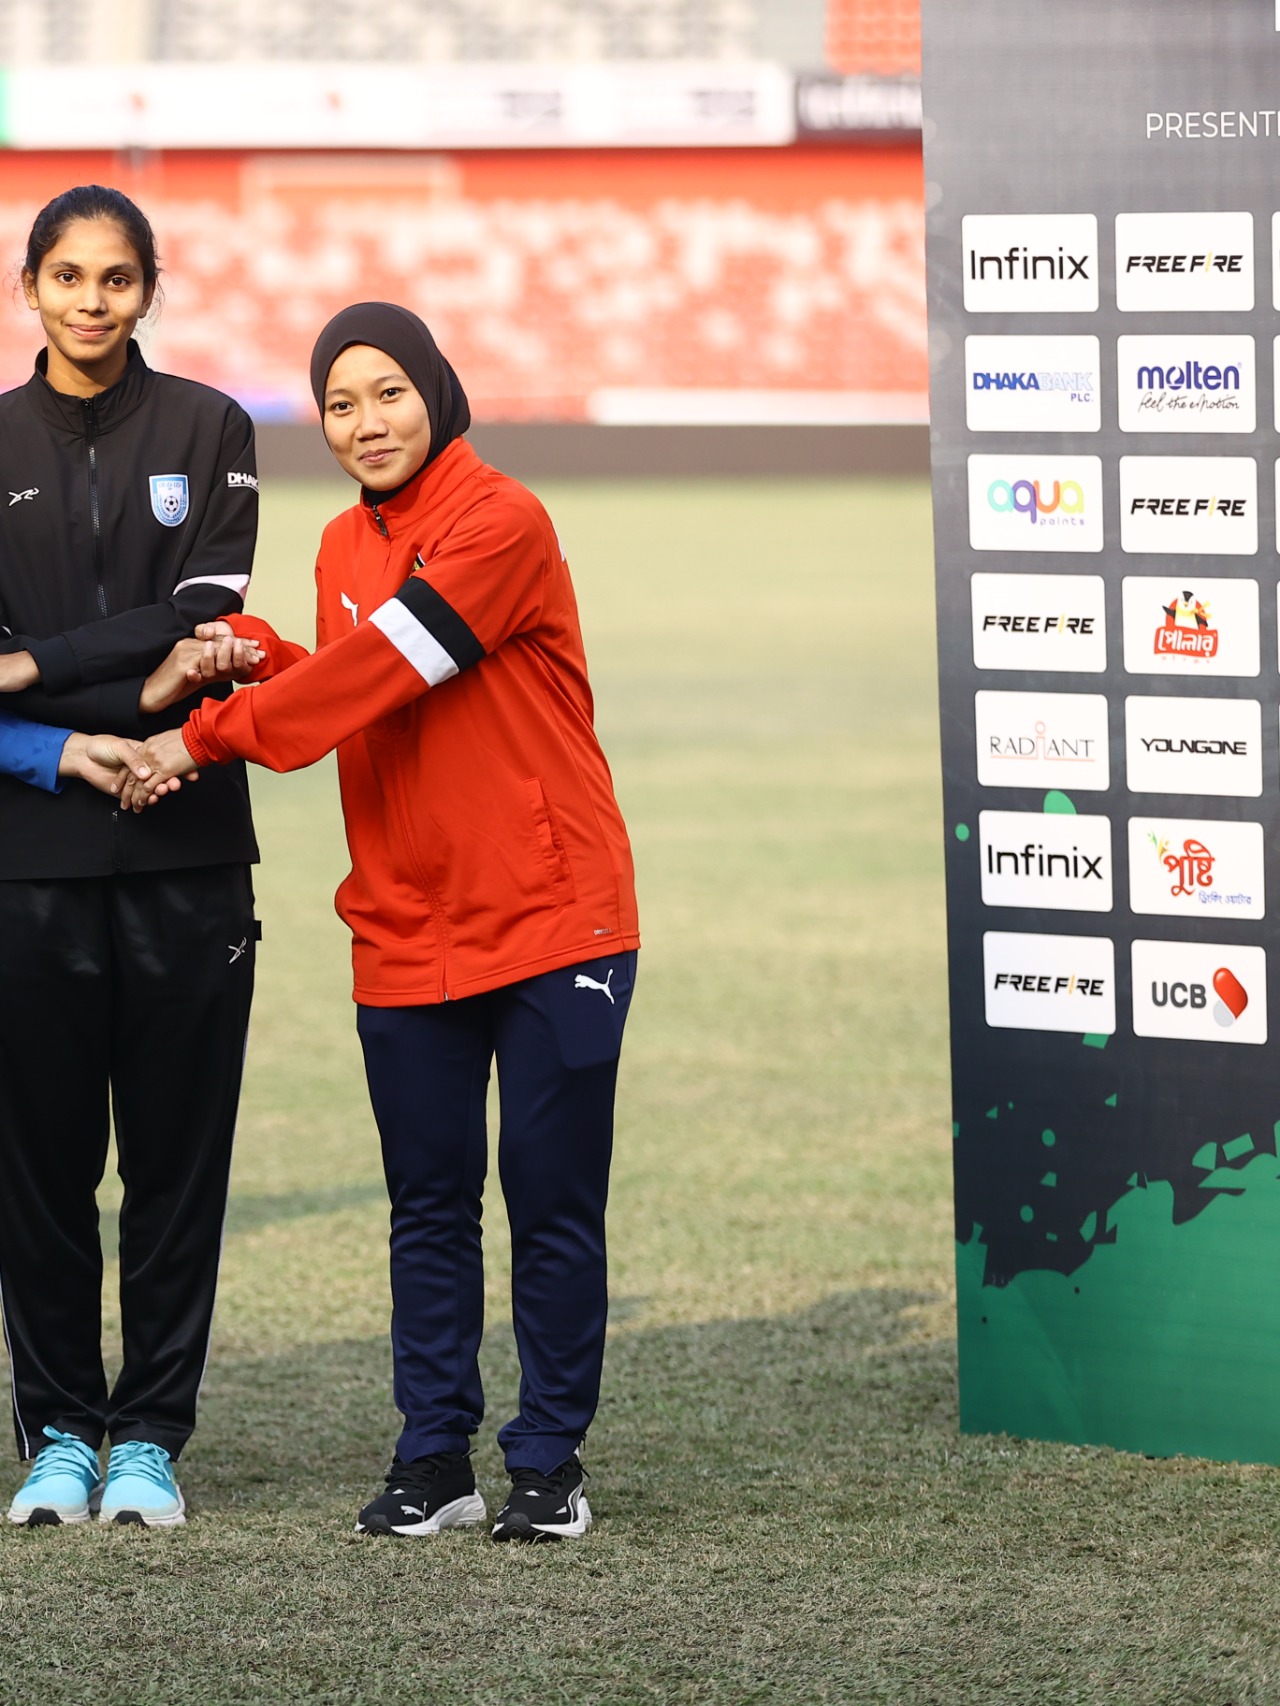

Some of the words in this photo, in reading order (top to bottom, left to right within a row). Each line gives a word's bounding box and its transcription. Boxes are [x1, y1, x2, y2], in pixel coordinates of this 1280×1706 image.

[1147, 110, 1280, 138] PRESENT
[971, 247, 1089, 280] Infinix
[1126, 255, 1187, 273] FREE
[973, 373, 1039, 390] DHAKA
[1137, 361, 1240, 390] molten
[987, 480, 1084, 524] aqua
[1130, 498, 1191, 516] FREE
[1040, 516, 1084, 526] paints
[982, 615, 1041, 633] FREE
[1140, 738, 1247, 756] YOUNGONE
[988, 843, 1103, 880] Infinix
[994, 973, 1052, 993] FREE
[1151, 981, 1207, 1009] UCB
